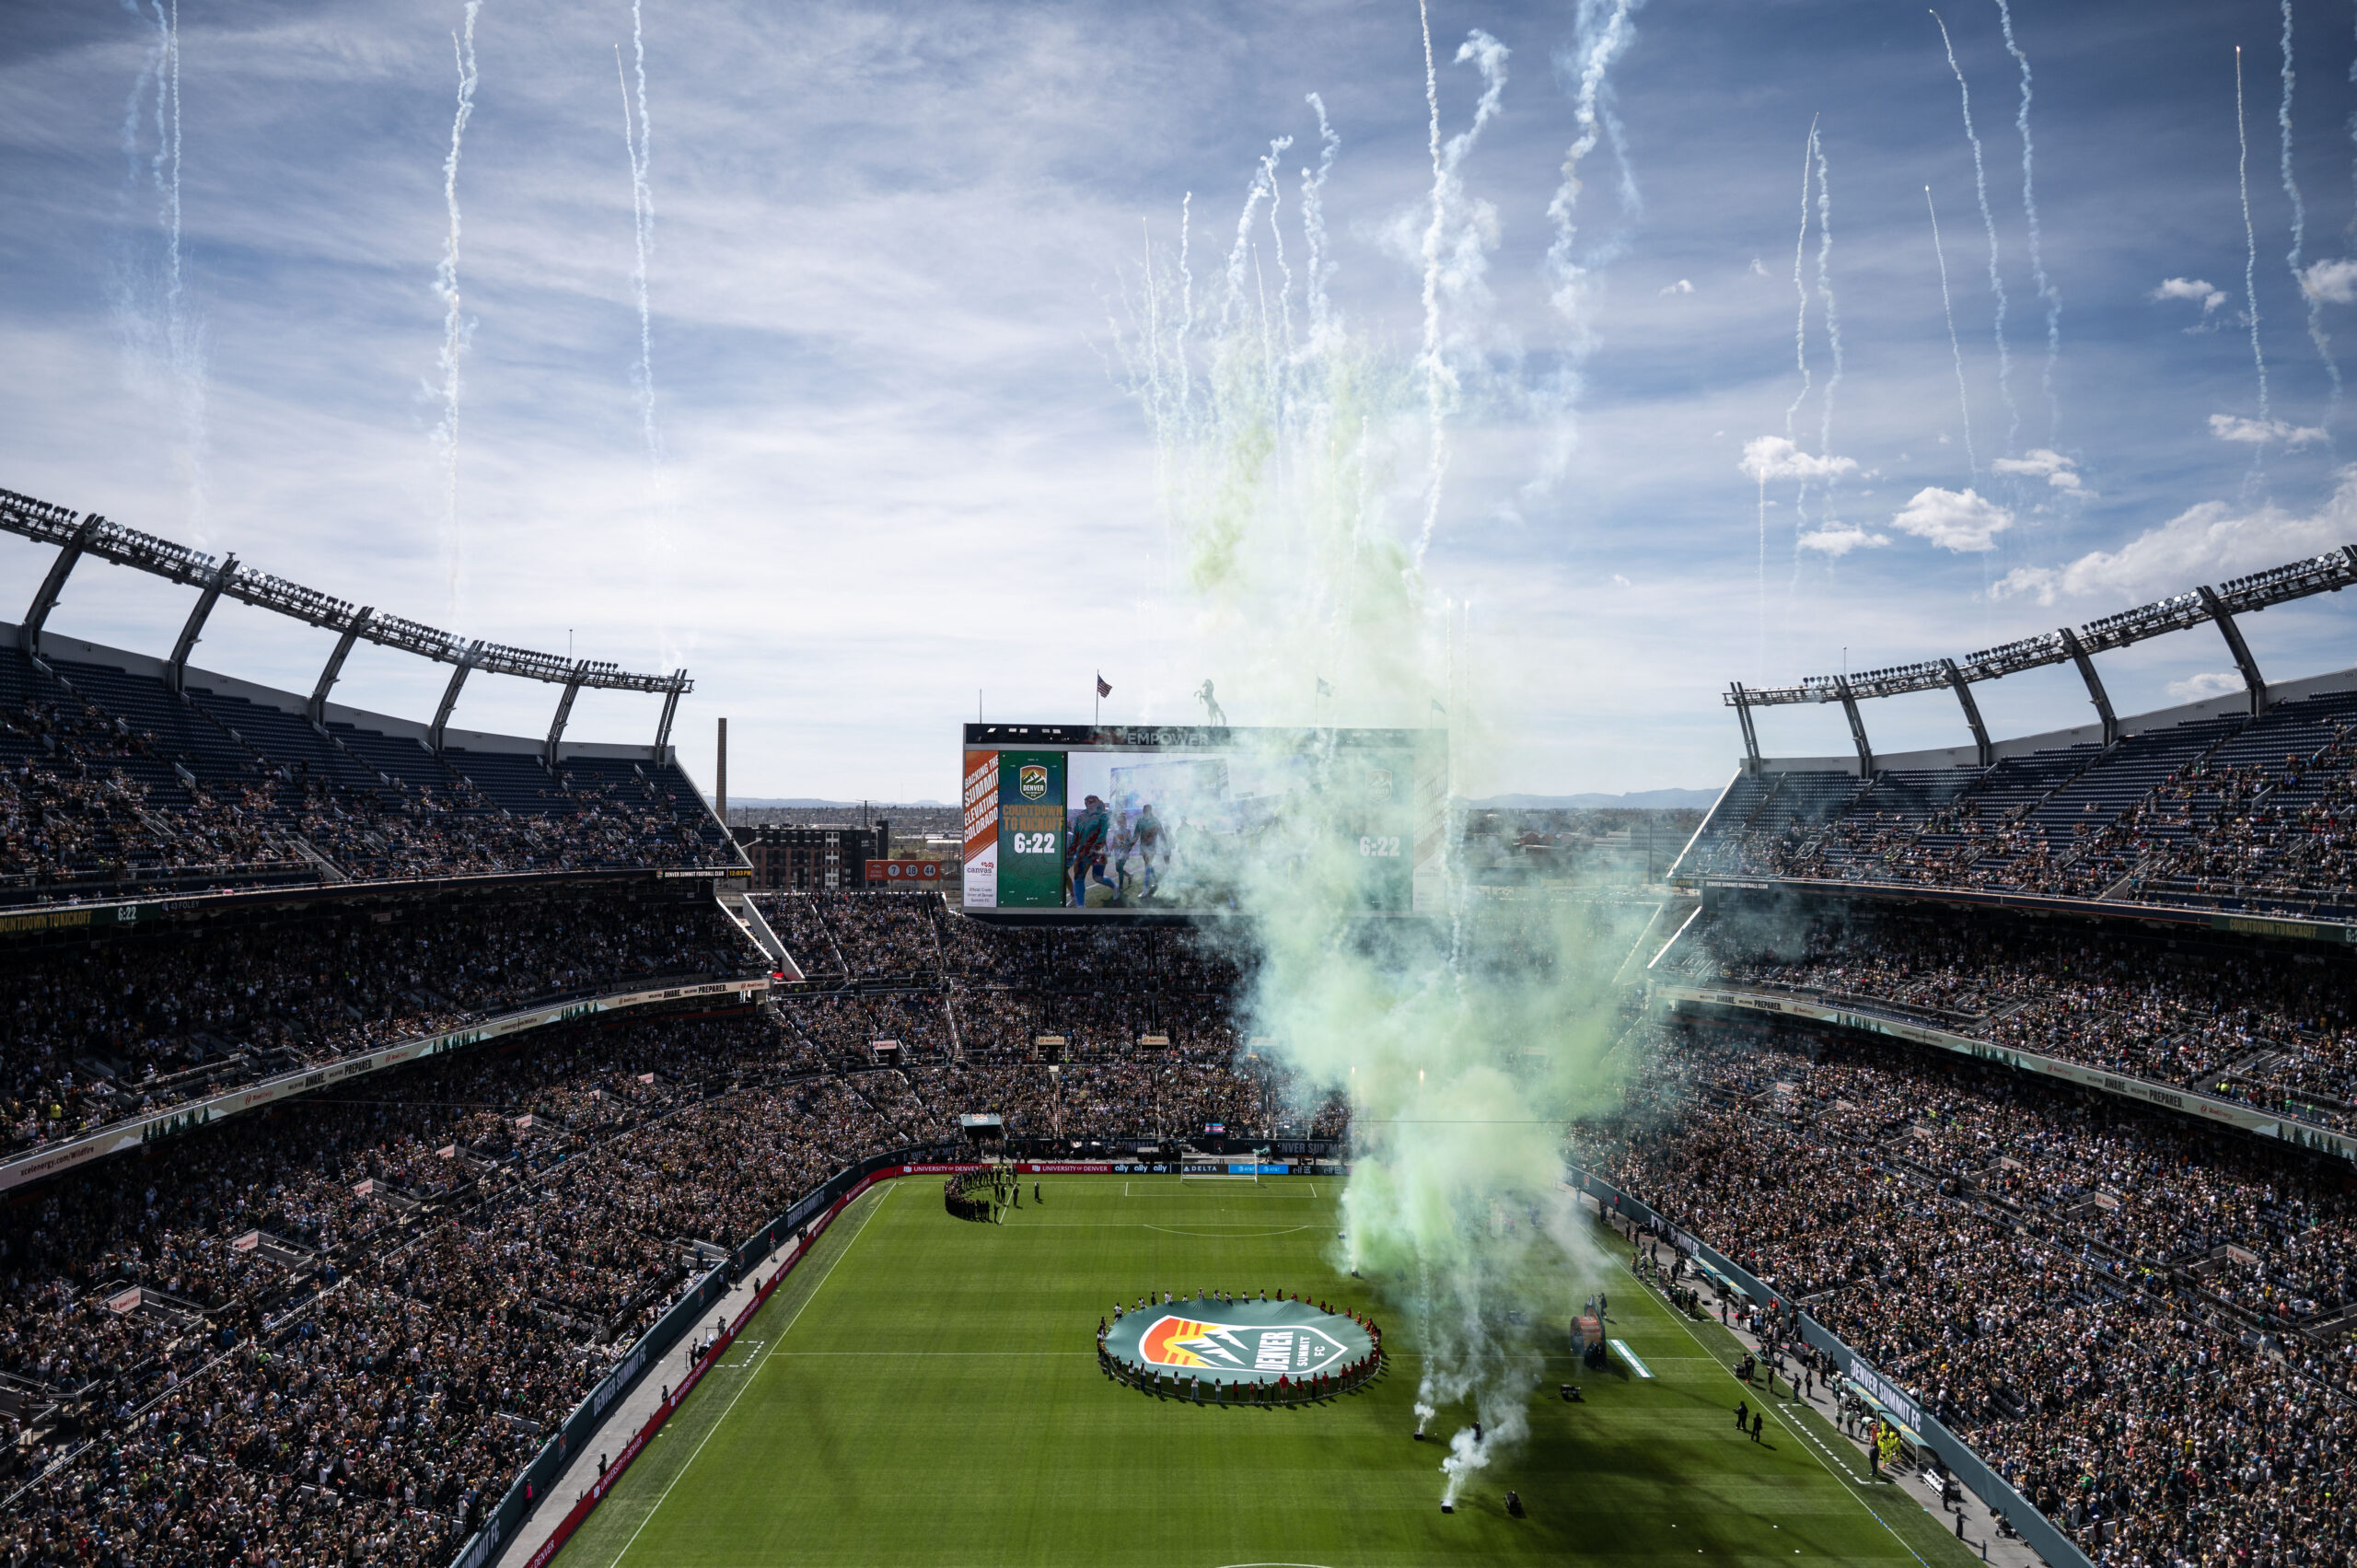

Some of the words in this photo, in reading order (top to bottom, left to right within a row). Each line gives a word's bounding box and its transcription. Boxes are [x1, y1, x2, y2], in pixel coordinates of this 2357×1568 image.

[1127, 732, 1209, 746] EMPOWER
[965, 762, 989, 789] BACKING
[989, 754, 999, 770] THE
[965, 768, 999, 807] SUMMIT
[964, 790, 999, 826] ELEVATING
[1003, 804, 1062, 816] COUNTDOWN
[964, 807, 999, 843] COLORADO
[1003, 816, 1018, 831] TO
[1019, 817, 1064, 831] KICKOFF
[1014, 832, 1055, 854] 6:22
[1359, 836, 1399, 857] 6:22
[924, 866, 935, 875] 44
[118, 906, 136, 921] 6:22
[179, 900, 200, 910] FOLEY
[60, 911, 92, 925] KICKOFF
[2229, 919, 2274, 935] COUNTDOWN
[2285, 923, 2317, 937] KICKOFF
[663, 989, 682, 998] AWARE.
[698, 984, 728, 993] PREPARED.
[1716, 994, 1736, 1004] AWARE.
[1754, 999, 1782, 1011] PREPARED.
[344, 1059, 373, 1075] PREPARED.
[305, 1072, 326, 1088] AWARE.
[2105, 1077, 2127, 1093] AWARE.
[2149, 1089, 2185, 1109] PREPARED.
[20, 1145, 94, 1177] xcelenergy.com/Wildfire
[1115, 1164, 1129, 1174] ally
[1133, 1164, 1148, 1174] ally
[1153, 1164, 1167, 1174] ally
[787, 1205, 803, 1228] DENVER
[1692, 1241, 1700, 1257] FC
[1254, 1331, 1294, 1371] DENVER
[1296, 1336, 1310, 1367] SUMMIT
[1314, 1345, 1326, 1357] FC
[695, 1358, 708, 1376] DENVER
[594, 1377, 616, 1417] DENVER
[616, 1352, 640, 1390] SUMMIT
[640, 1344, 646, 1365] FC
[1850, 1358, 1878, 1396] DENVER
[1879, 1382, 1910, 1423] SUMMIT
[1910, 1409, 1922, 1433] FC
[600, 1460, 623, 1491] UNIVERSITY
[627, 1435, 643, 1458] DENVER
[491, 1518, 500, 1549] FC
[534, 1539, 554, 1568] DENVER
